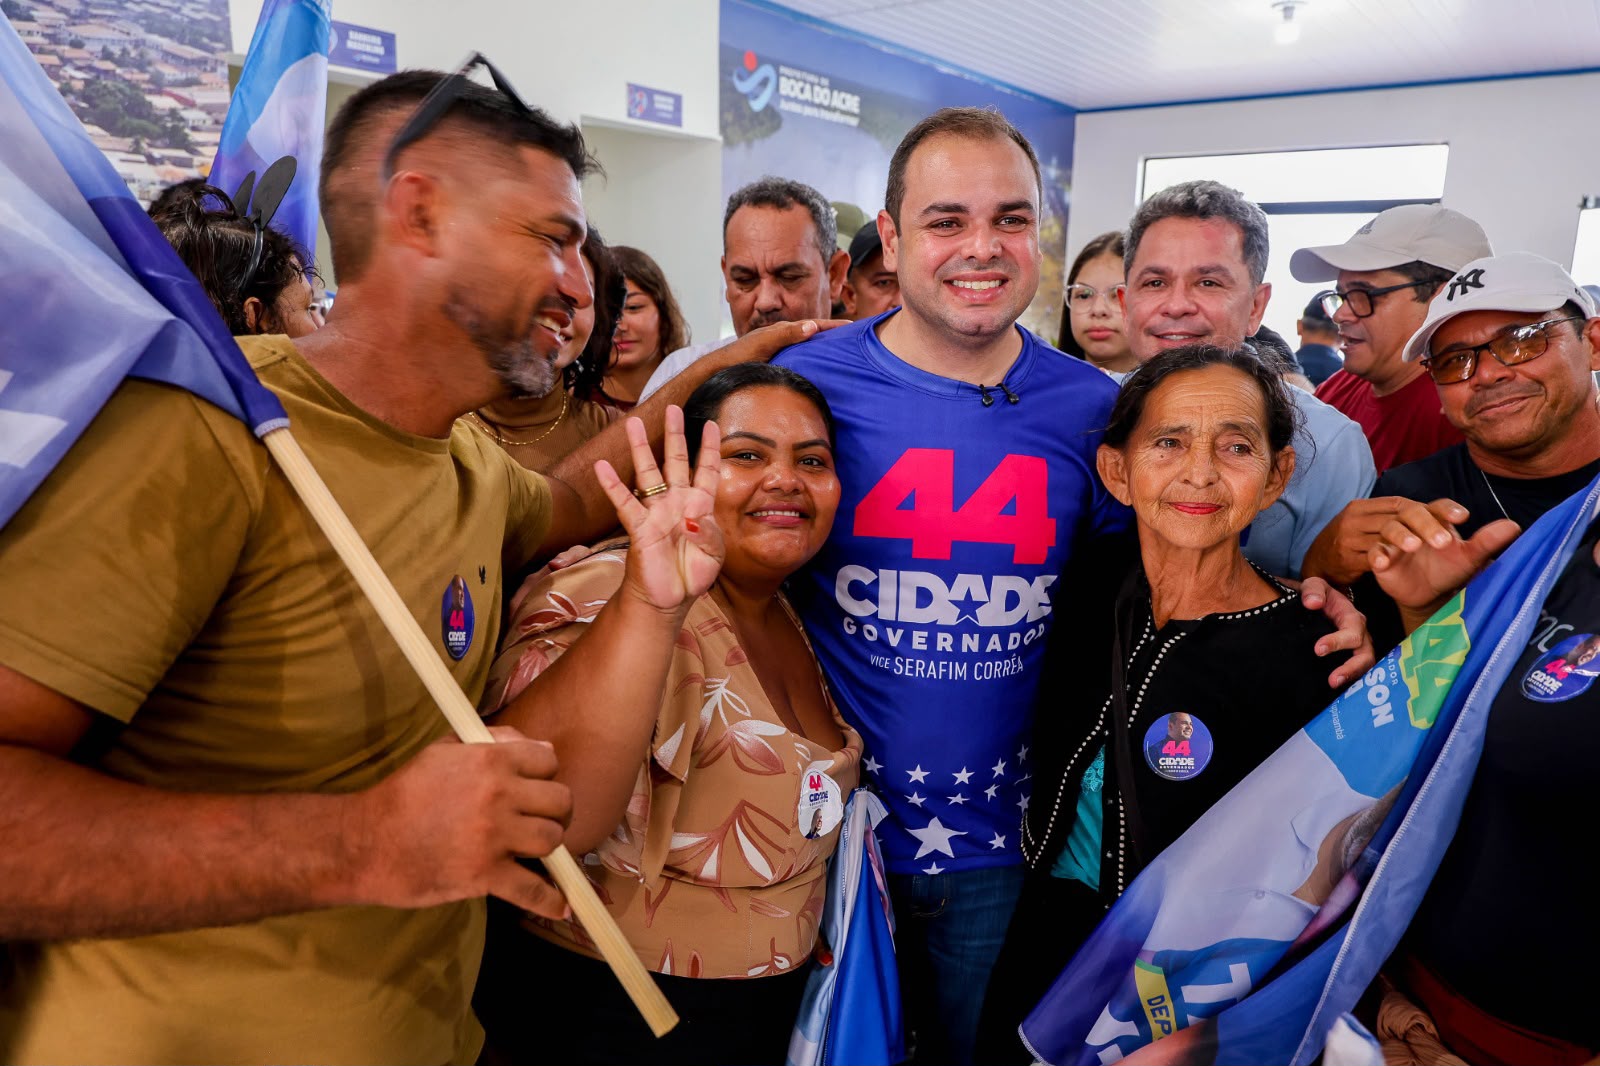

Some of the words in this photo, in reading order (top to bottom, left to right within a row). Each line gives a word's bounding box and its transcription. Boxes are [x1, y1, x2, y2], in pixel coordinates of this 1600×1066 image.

[779, 77, 812, 102] BOCA
[812, 85, 830, 105] DO
[830, 89, 861, 114] ACRE
[1447, 268, 1485, 301] NY
[853, 448, 1056, 564] 44
[835, 564, 1058, 627] CIDADE
[449, 610, 465, 630] 44
[843, 617, 1046, 653] GOVERNADOR
[870, 655, 890, 669] VICE
[893, 656, 967, 681] SERAFIM
[1364, 660, 1395, 728] SON
[1158, 757, 1195, 766] CIDADE
[1162, 740, 1191, 756] 44
[1147, 994, 1172, 1040] DEP
